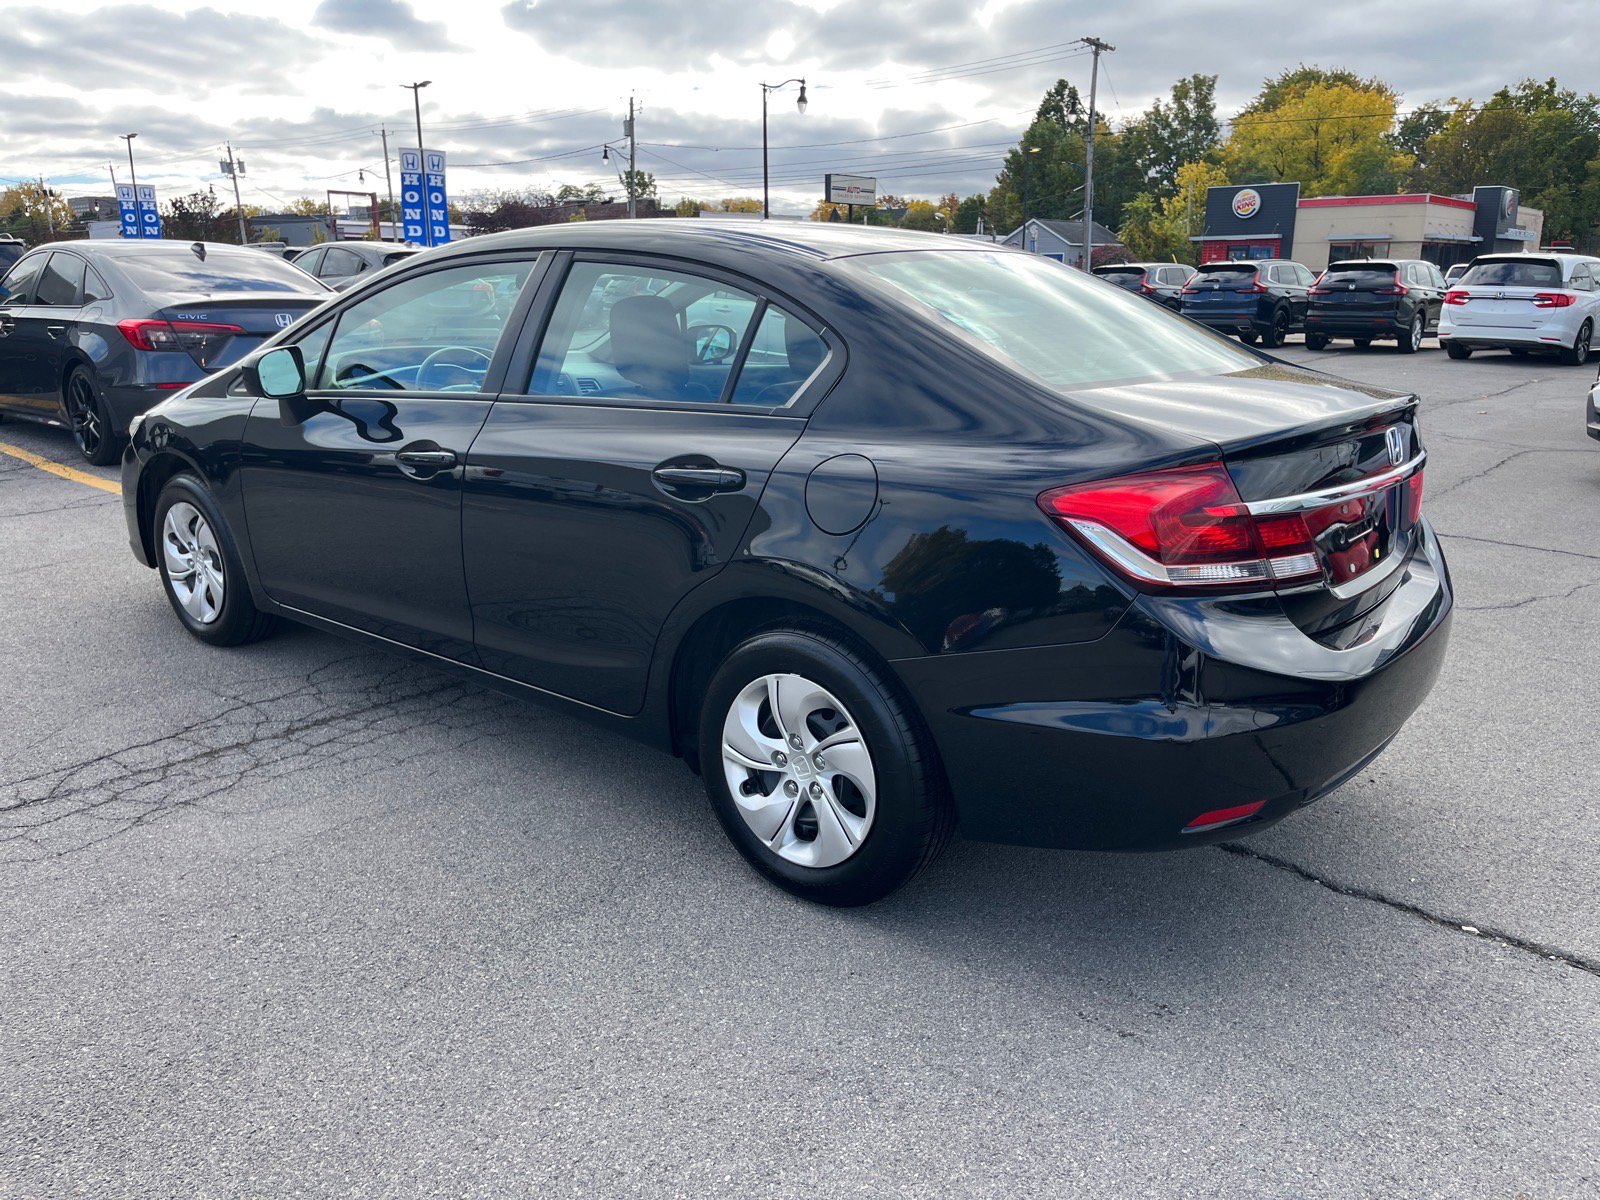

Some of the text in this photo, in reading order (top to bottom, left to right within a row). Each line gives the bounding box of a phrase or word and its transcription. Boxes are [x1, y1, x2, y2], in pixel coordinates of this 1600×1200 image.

[403, 174, 422, 246] HOND
[429, 175, 446, 246] HOND
[1236, 200, 1256, 211] KING
